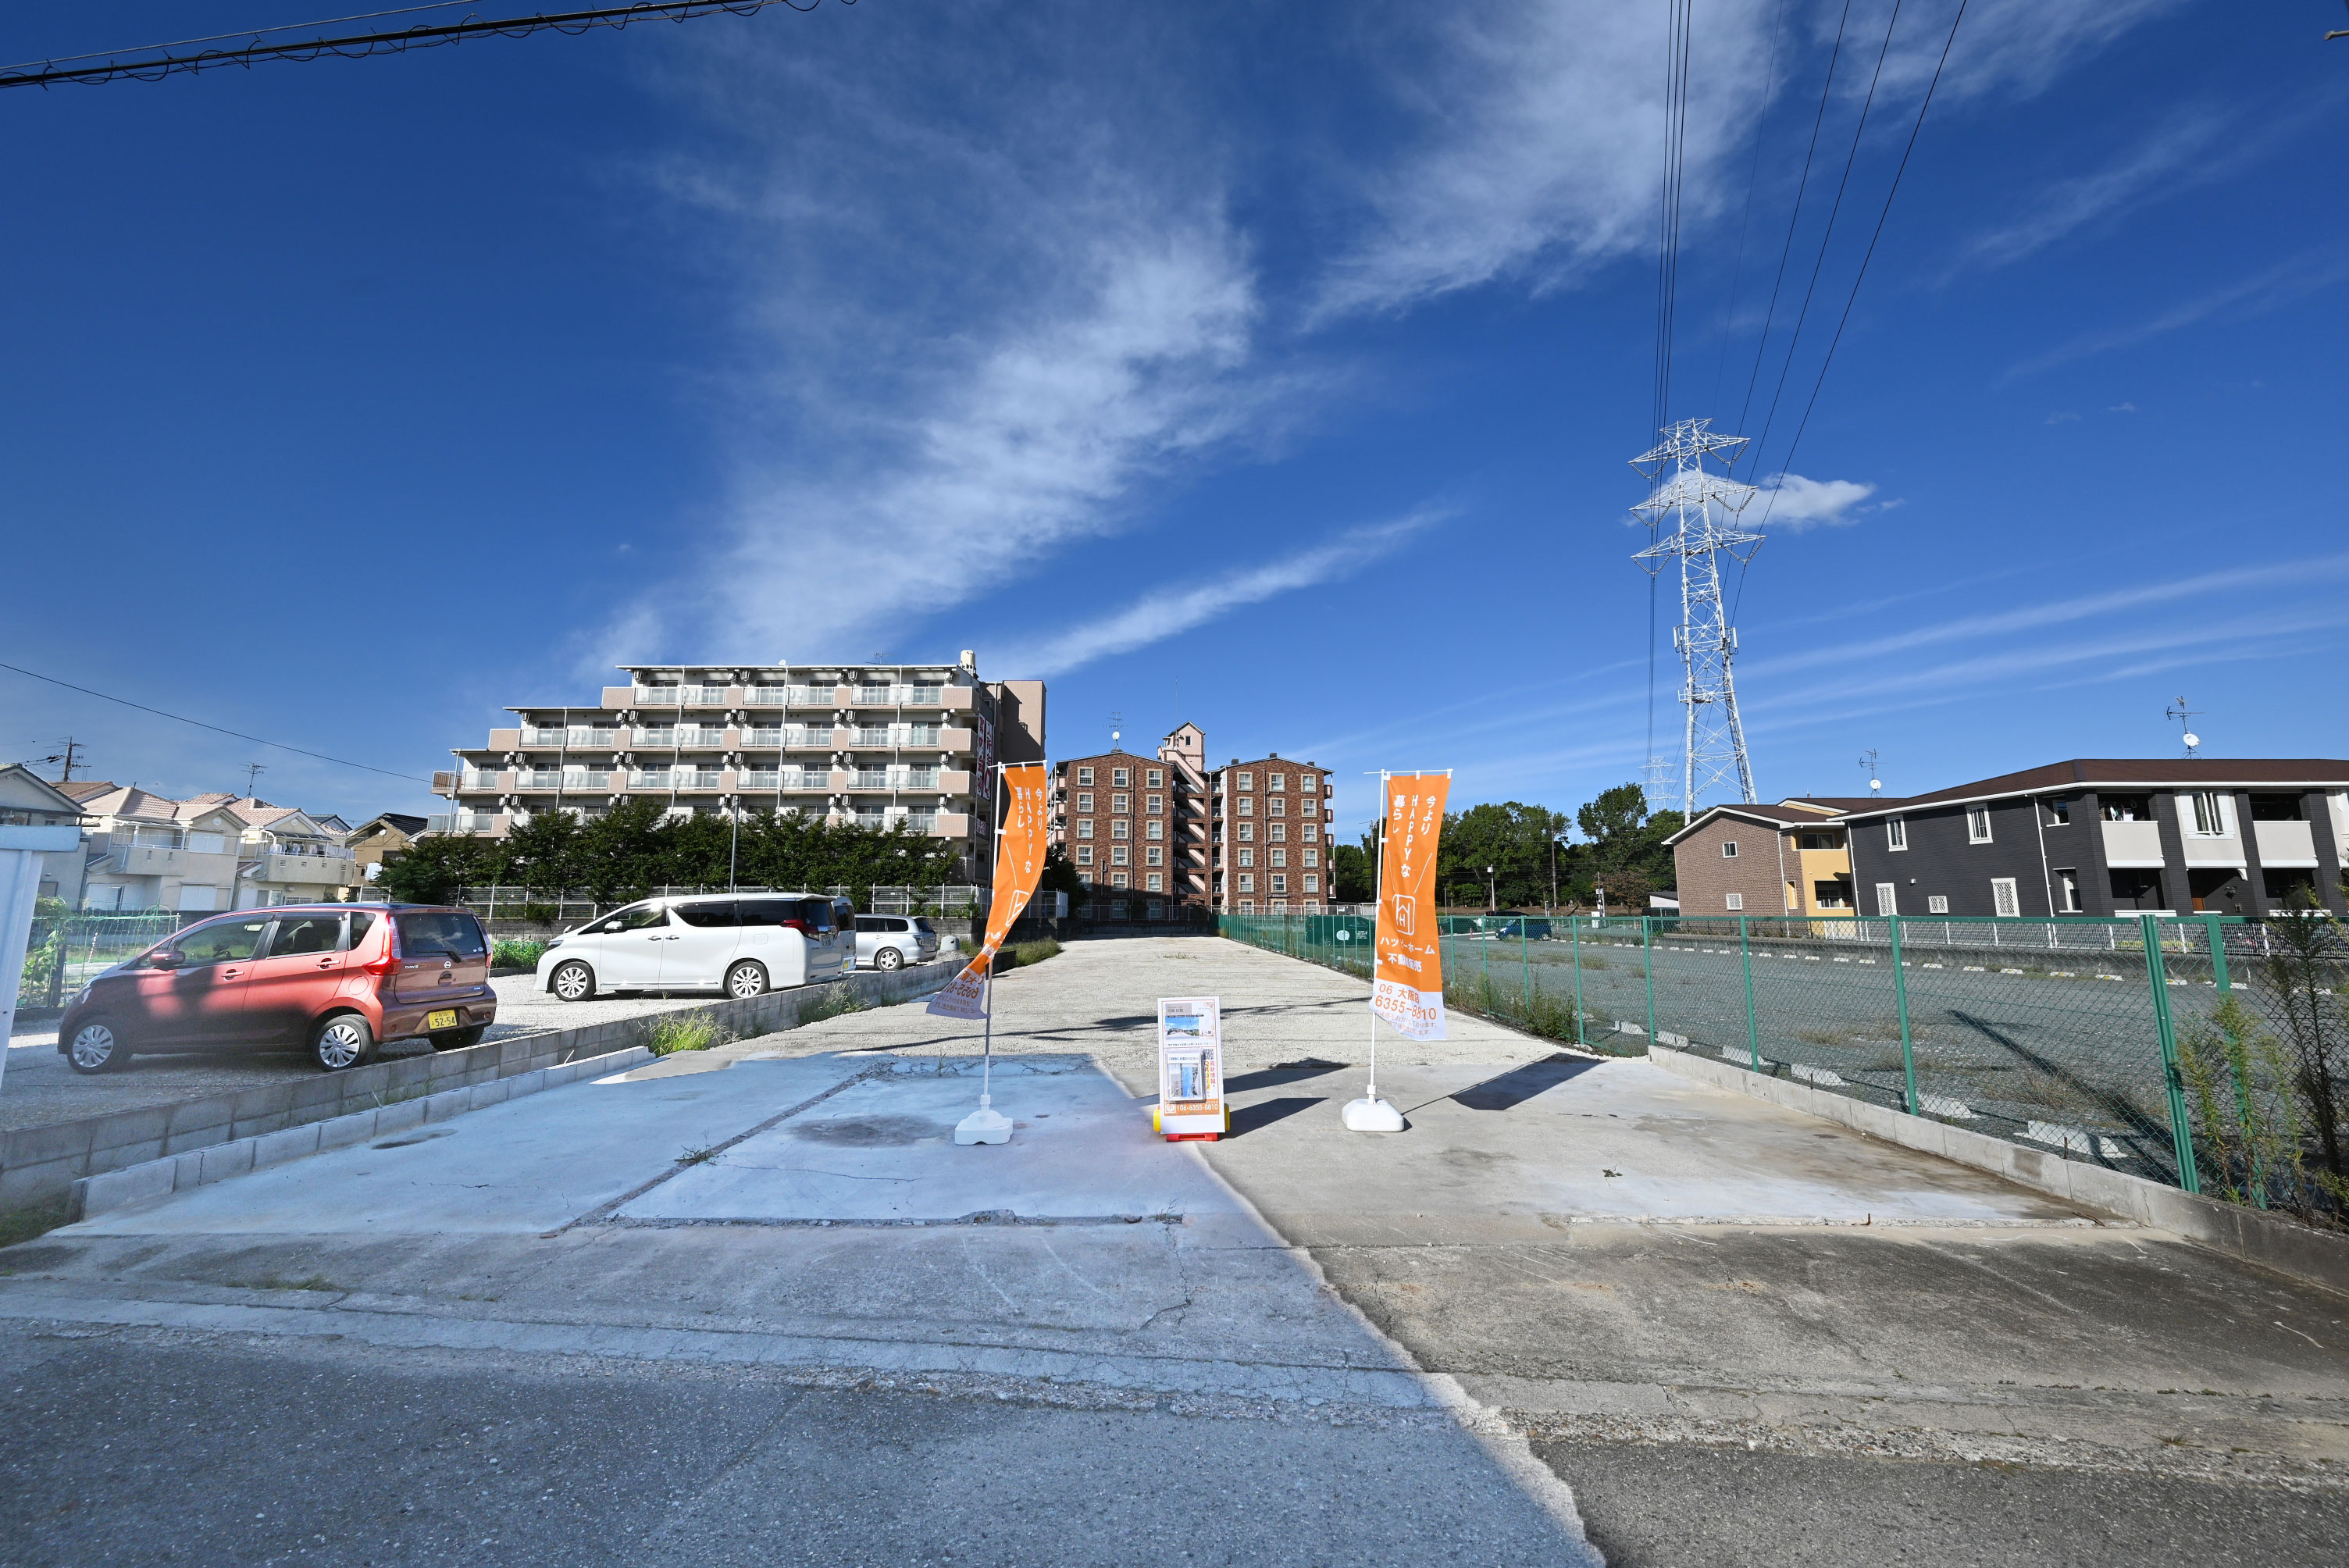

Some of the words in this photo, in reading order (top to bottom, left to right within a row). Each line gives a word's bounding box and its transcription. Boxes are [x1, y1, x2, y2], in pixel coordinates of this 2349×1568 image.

[1015, 786, 1025, 829] 暮らし
[1392, 794, 1406, 834] 暮らし
[1420, 795, 1437, 836] 今より
[1025, 787, 1033, 874] HAPPYな
[1400, 794, 1419, 878] HAPPYな
[1374, 995, 1438, 1021] 6355-8810
[1379, 983, 1393, 995] 06
[1397, 988, 1420, 1005] 大阪店
[435, 1016, 455, 1027] 52-54
[1179, 1103, 1218, 1112] 06-6355-8810
